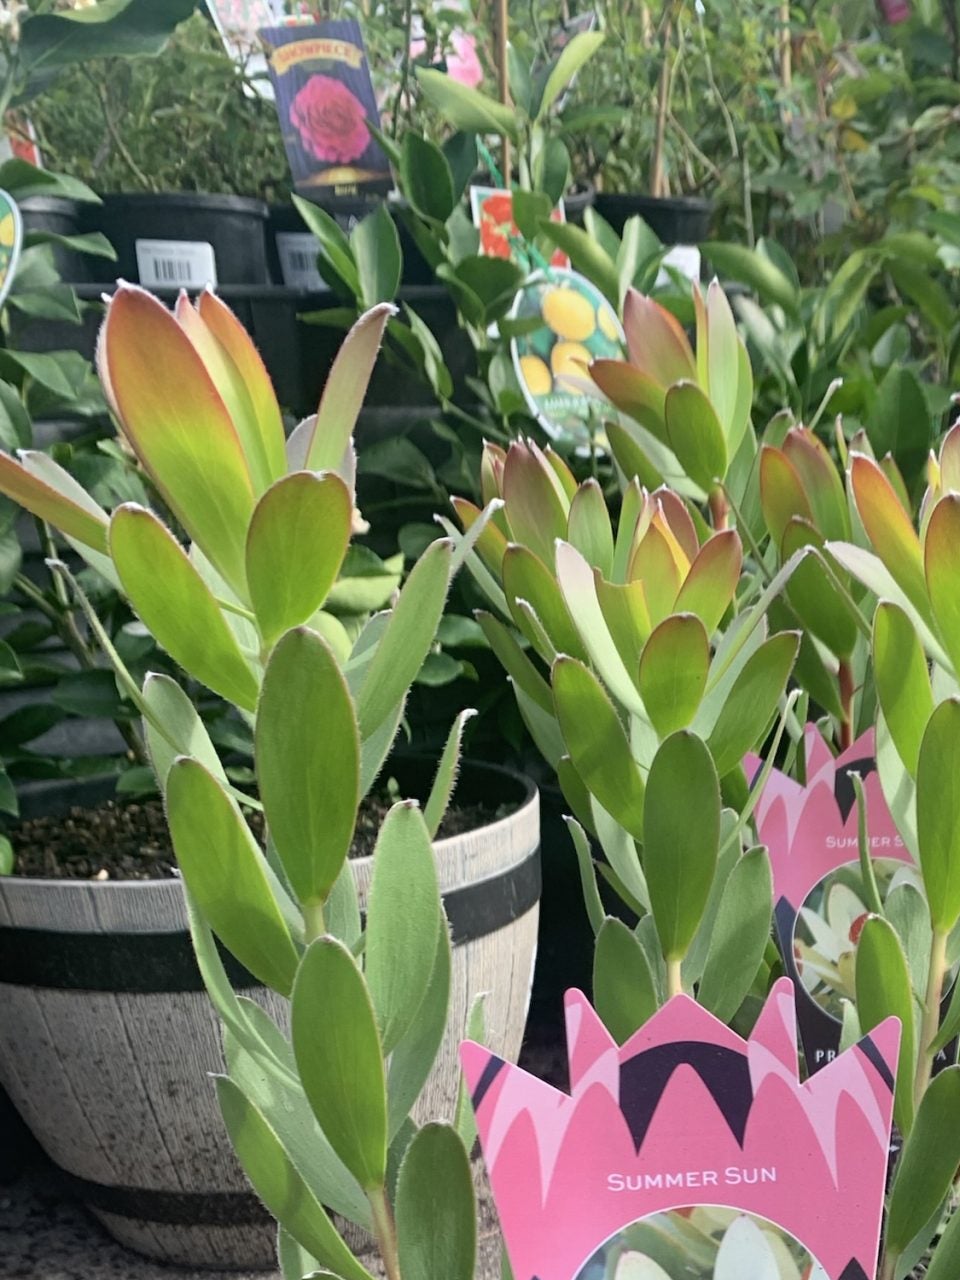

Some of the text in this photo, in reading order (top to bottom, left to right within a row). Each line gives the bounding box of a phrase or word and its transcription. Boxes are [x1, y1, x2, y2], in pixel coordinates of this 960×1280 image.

[826, 836, 891, 848] SUMER
[607, 1166, 777, 1192] SUMMER SUN
